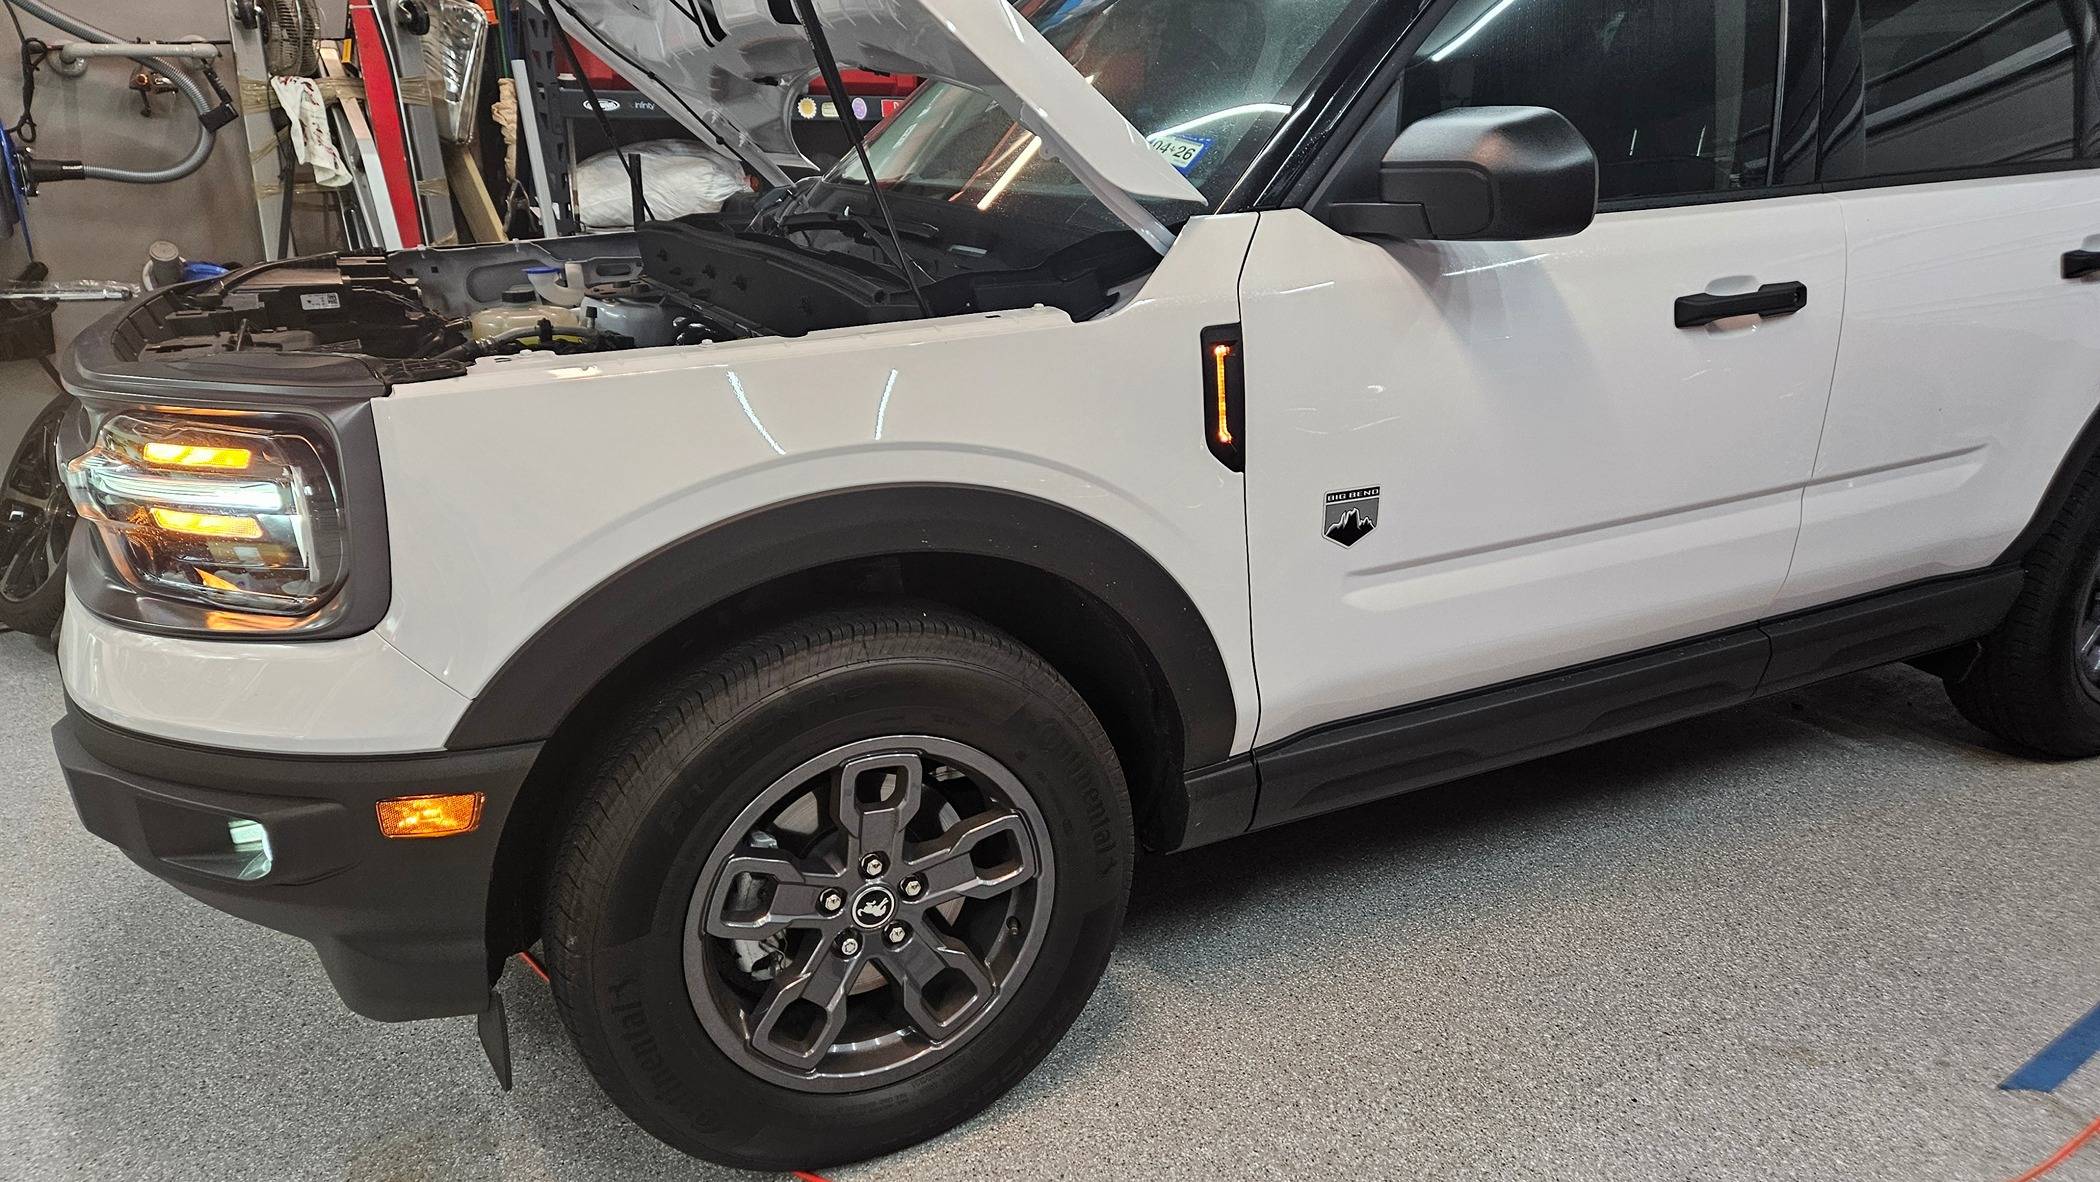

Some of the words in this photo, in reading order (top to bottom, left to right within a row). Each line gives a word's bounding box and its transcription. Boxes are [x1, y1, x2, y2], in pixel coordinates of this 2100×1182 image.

[1173, 145, 1196, 160] 26
[1327, 493, 1346, 501] BIG
[1349, 489, 1379, 498] BEND
